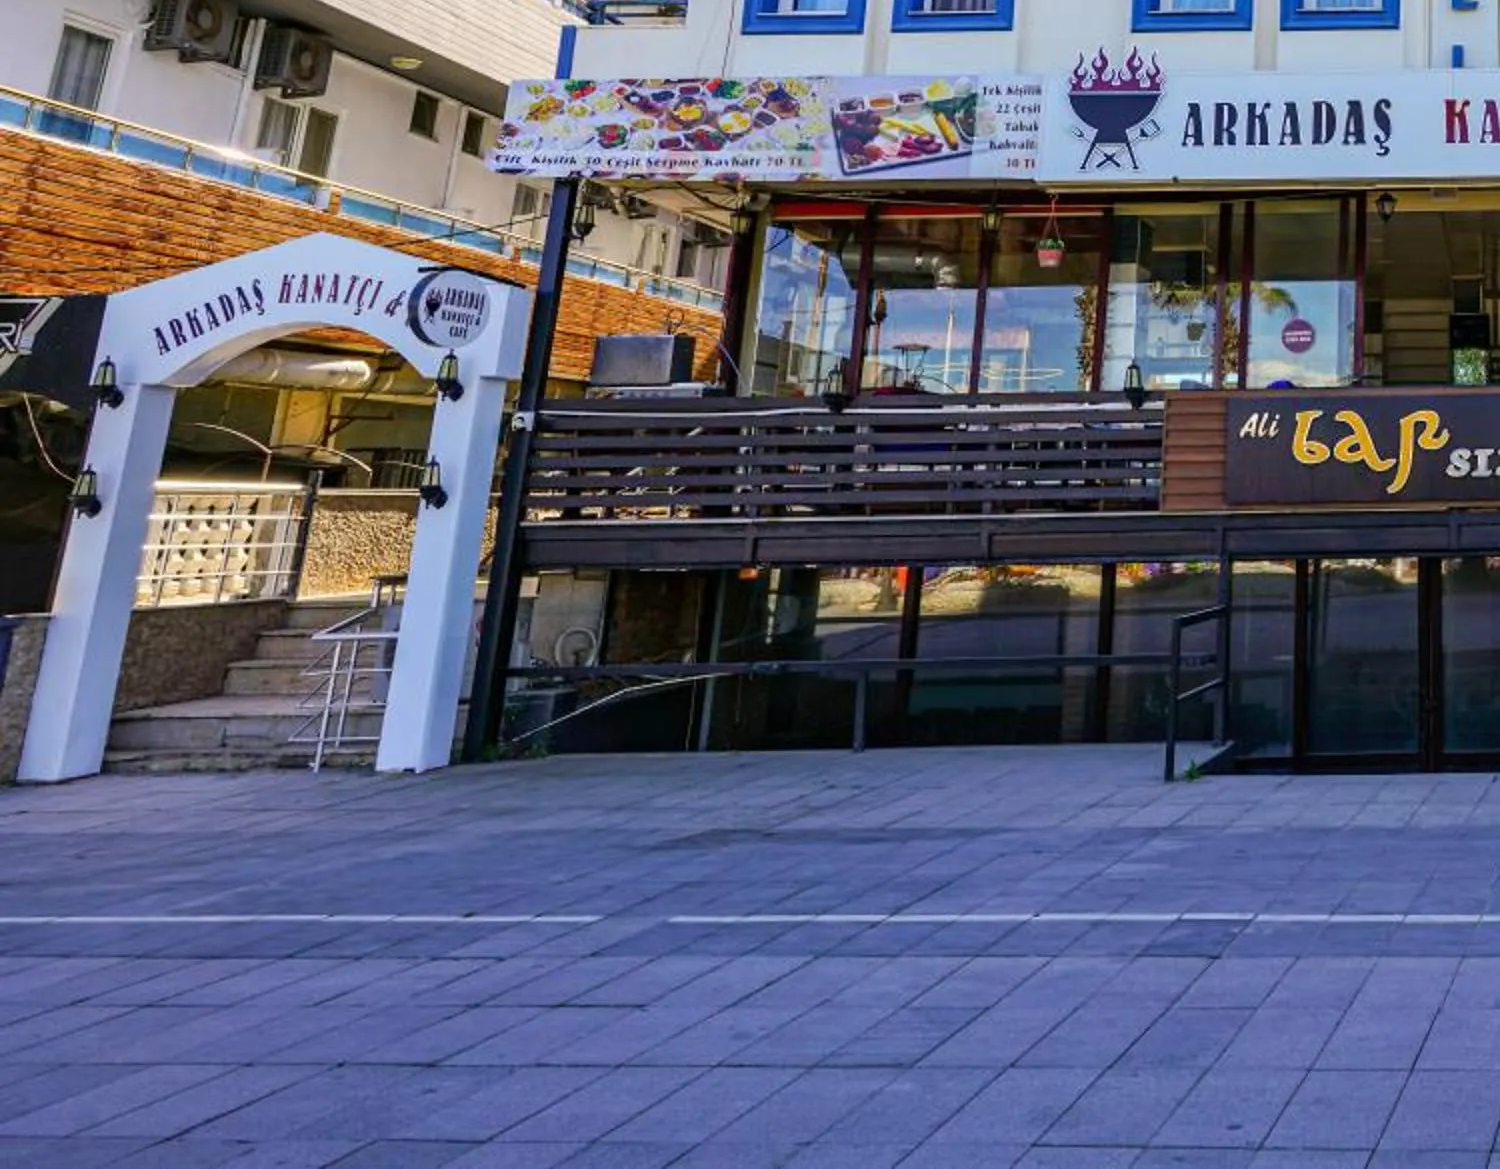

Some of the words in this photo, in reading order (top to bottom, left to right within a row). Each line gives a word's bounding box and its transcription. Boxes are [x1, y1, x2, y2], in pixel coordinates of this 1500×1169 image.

[1181, 97, 1393, 157] ARKADAŞ
[152, 277, 266, 357] ARKADAŞ
[277, 273, 384, 316] KANATÇI
[1239, 411, 1281, 439] Ali
